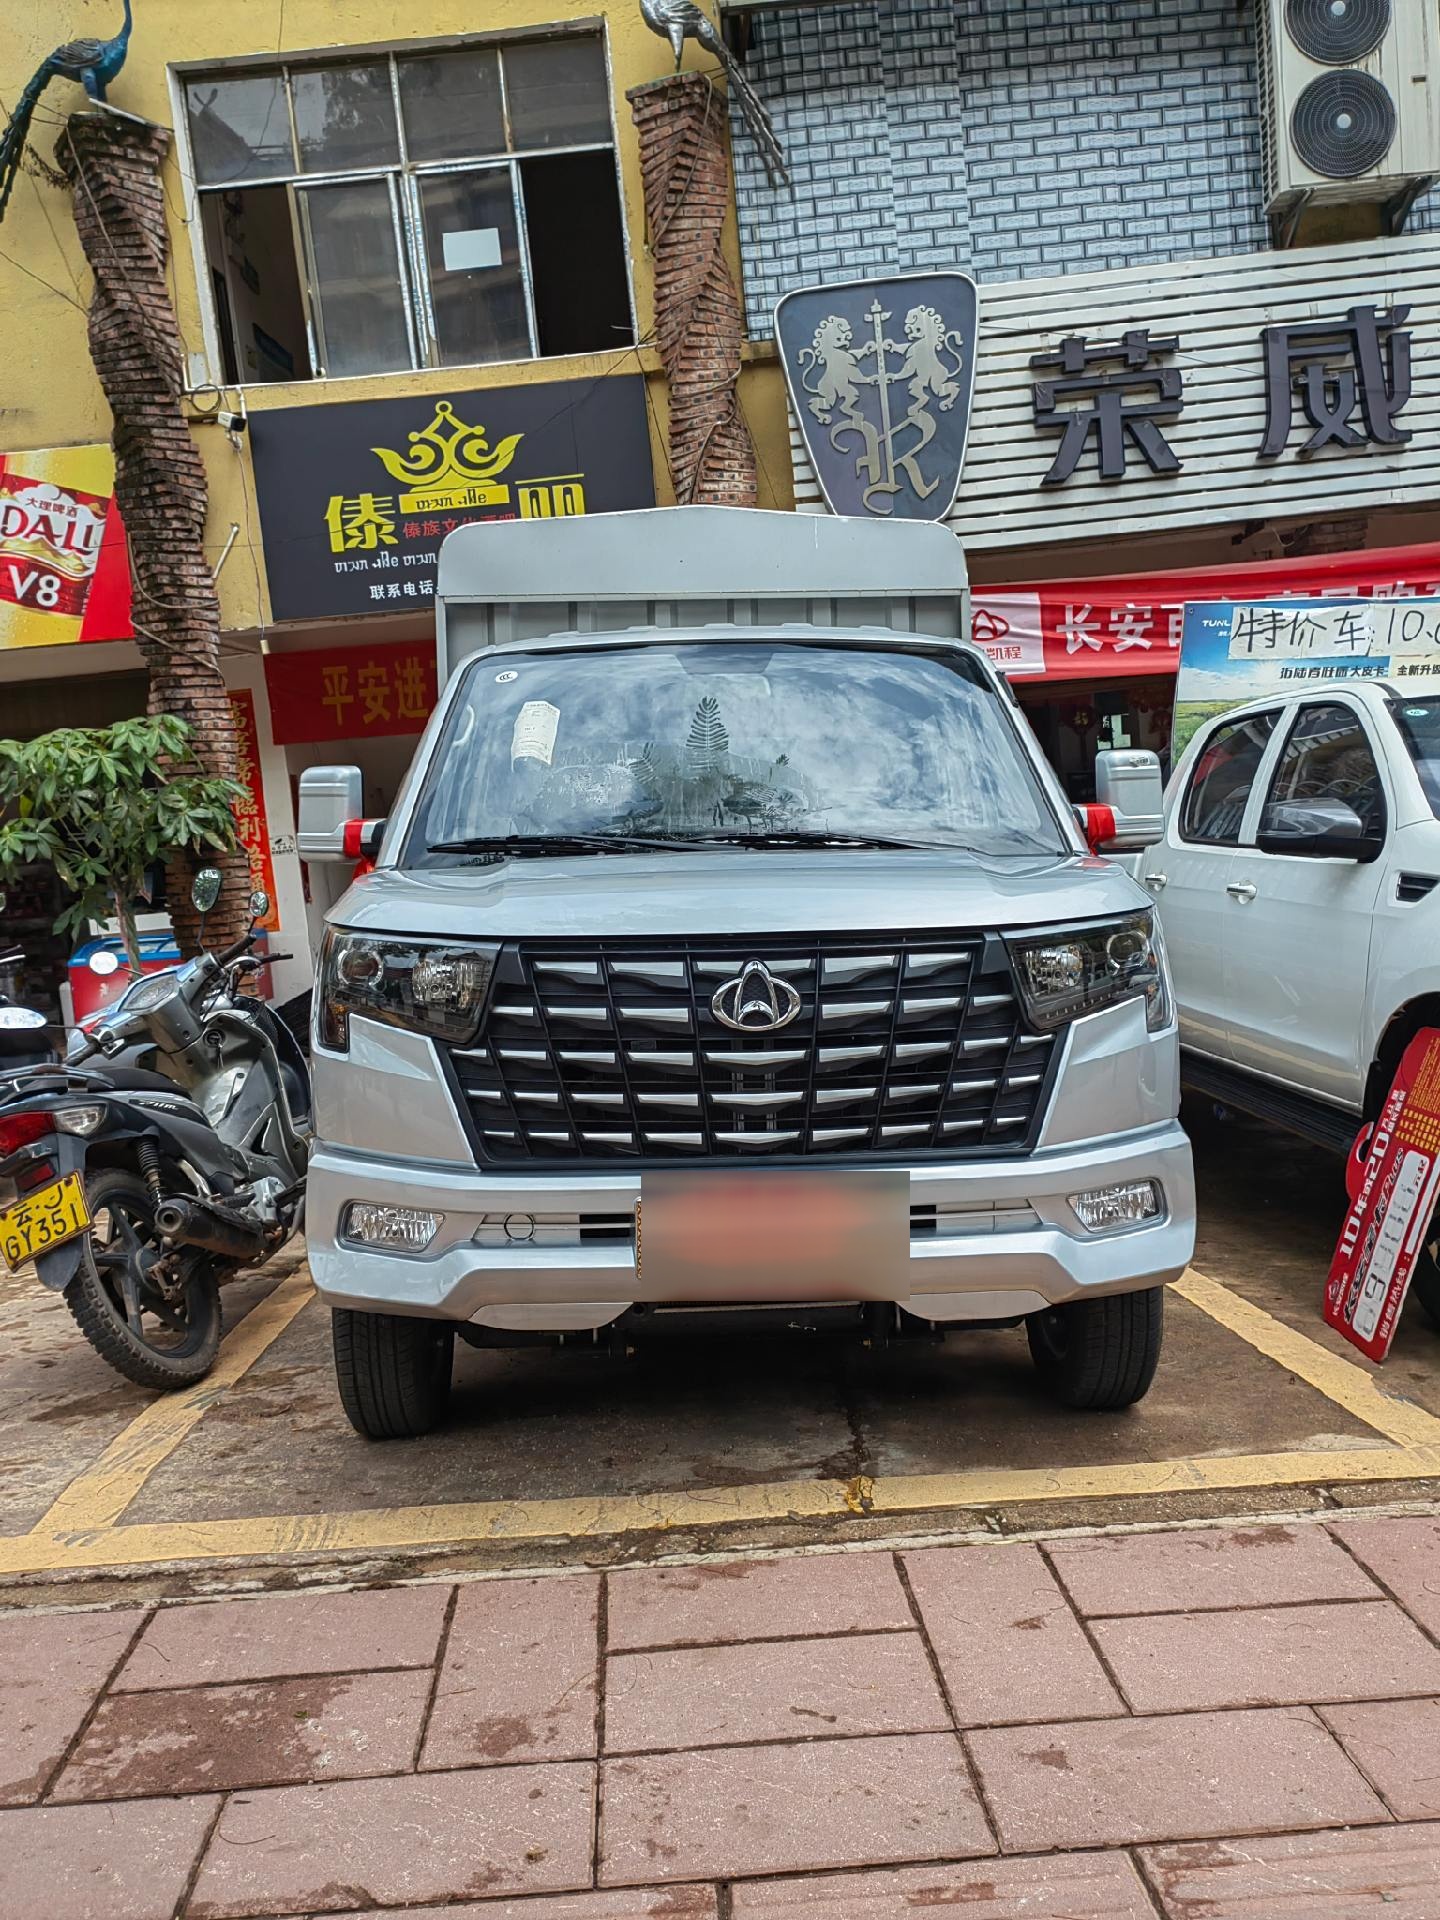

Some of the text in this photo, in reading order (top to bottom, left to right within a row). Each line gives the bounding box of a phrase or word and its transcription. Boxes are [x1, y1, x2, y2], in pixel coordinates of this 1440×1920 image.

[1029, 304, 1412, 486] 荣威
[1, 505, 95, 556] DALI
[26, 497, 79, 518] 大理啤酒
[323, 493, 399, 553] 傣
[8, 564, 61, 607] V8
[322, 656, 436, 726] 平安进
[6, 1203, 79, 1260] GY351
